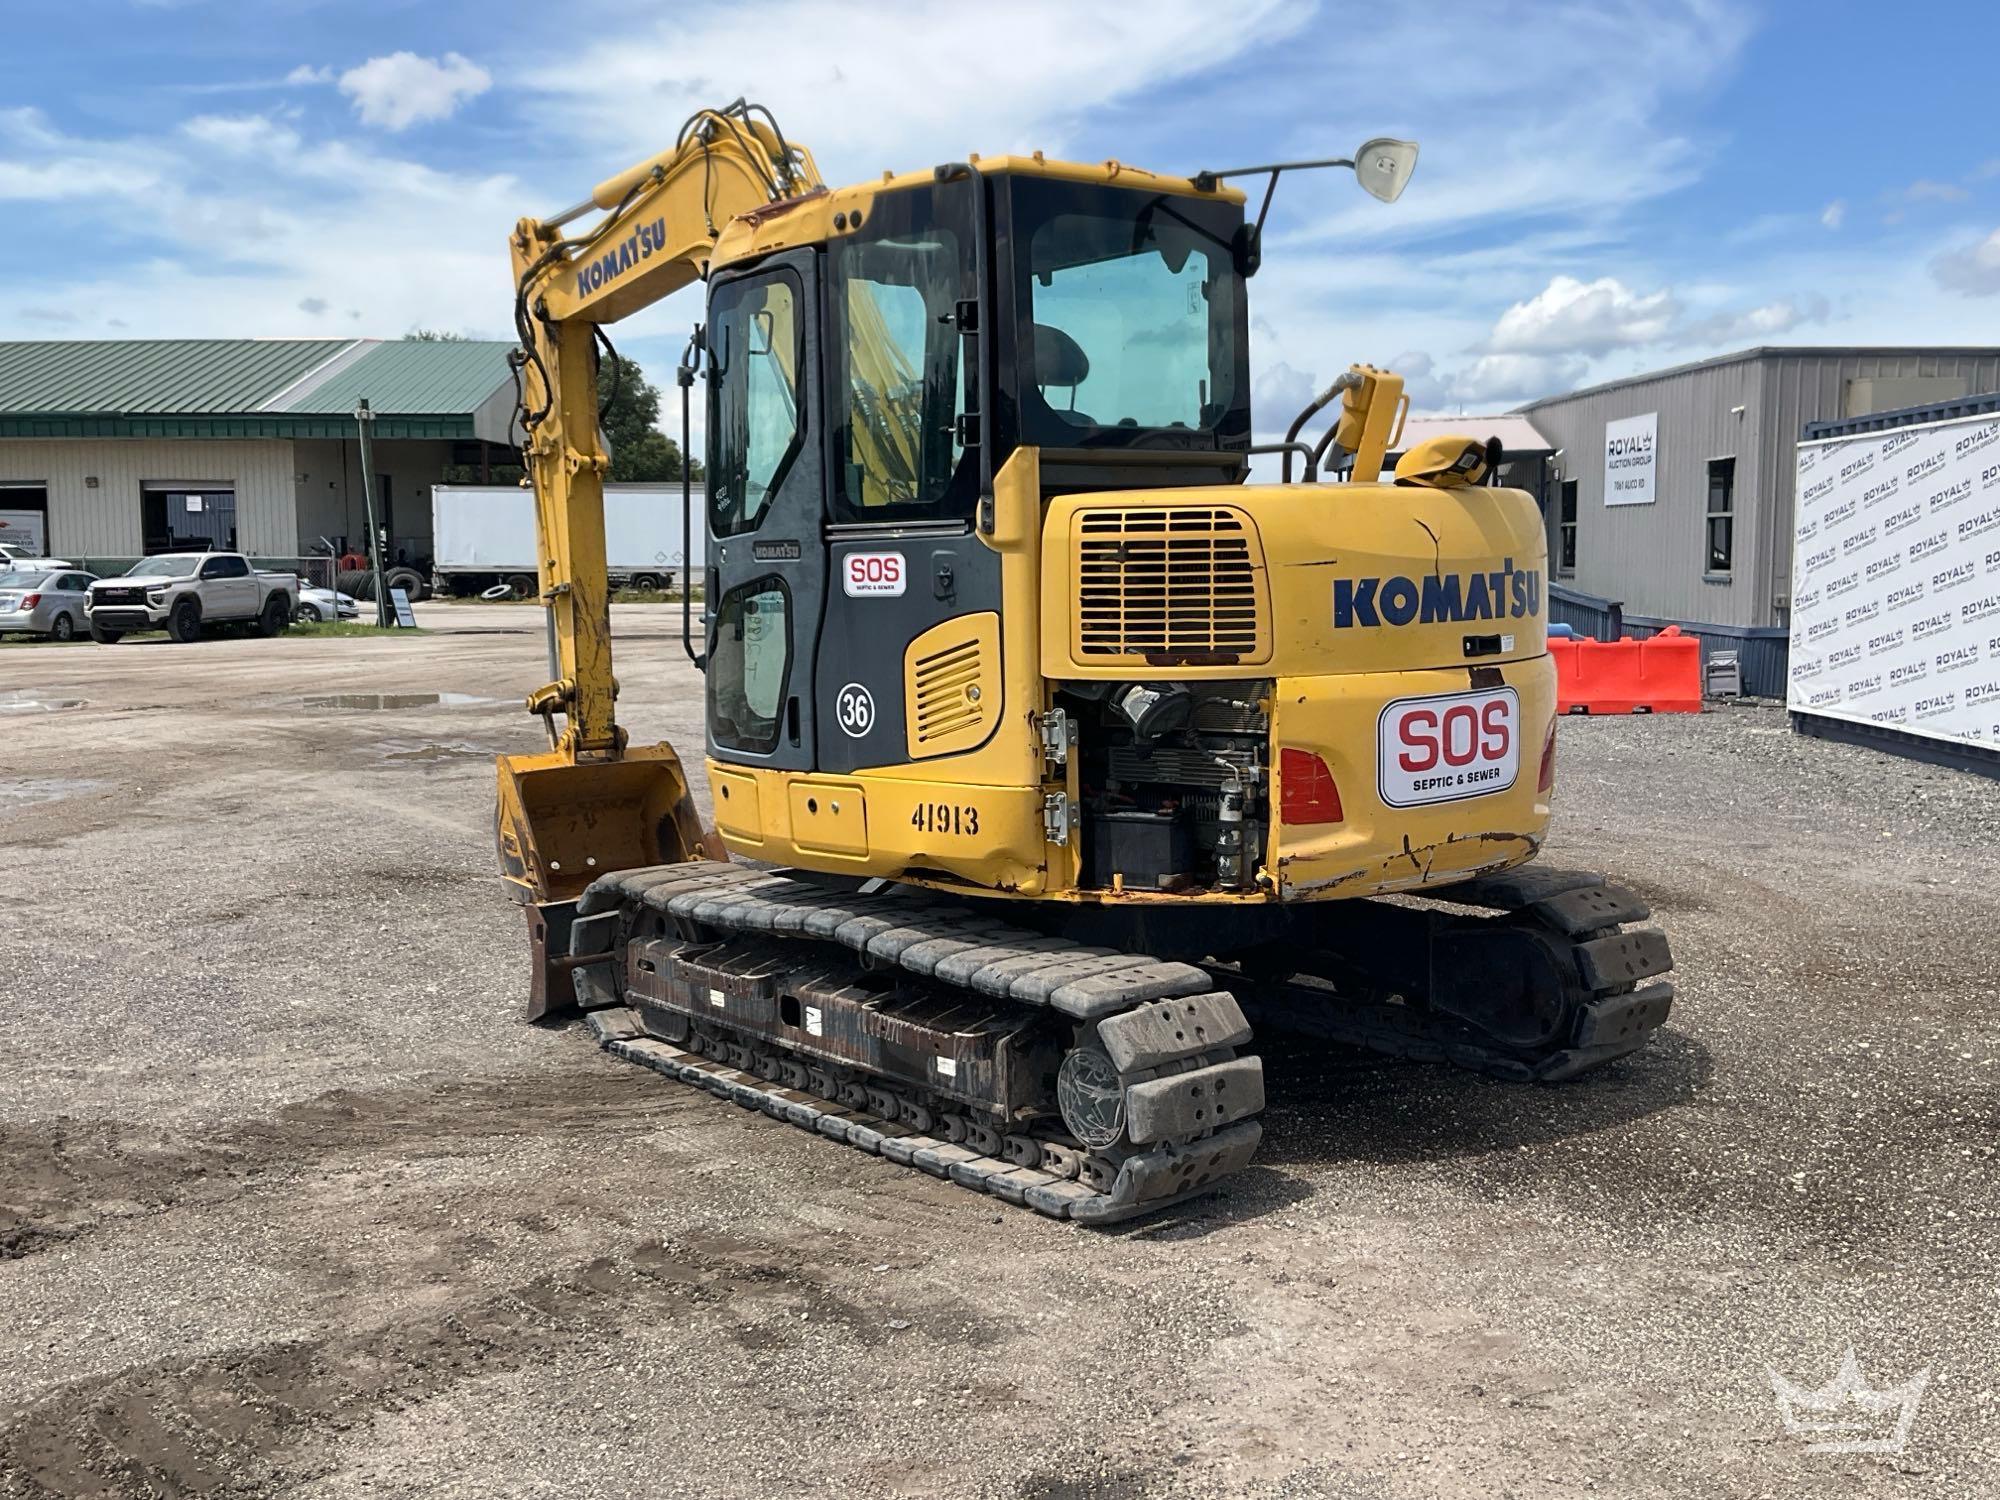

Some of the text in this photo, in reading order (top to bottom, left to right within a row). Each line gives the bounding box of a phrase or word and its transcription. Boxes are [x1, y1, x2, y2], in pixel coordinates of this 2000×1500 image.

[578, 217, 666, 300] KOMATSU
[1608, 436, 1642, 456] ROYAL
[1956, 429, 1989, 452] ROYAL
[1608, 456, 1652, 469] AUCTION GROUP
[1841, 457, 1866, 477] ROYAL
[1907, 457, 1937, 478] ROYAL
[1864, 481, 1890, 501] ROYAL
[1930, 485, 1962, 506] ROYAL
[1884, 509, 1913, 528] ROYAL
[1958, 513, 1992, 534] ROYAL
[756, 543, 799, 558] KOMATSU
[1909, 536, 1939, 555] ROYAL
[851, 558, 899, 582] SOS
[1866, 558, 1892, 575] ROYAL
[1933, 566, 1965, 585] ROYAL
[1334, 558, 1540, 628] KOMATSU
[1888, 586, 1916, 603] ROYAL
[1962, 597, 1996, 616] ROYAL
[1912, 616, 1942, 633] ROYAL
[1868, 634, 1895, 649] ROYAL
[1936, 649, 1968, 665] ROYAL
[1890, 665, 1918, 680] ROYAL
[1965, 683, 2000, 698] ROYAL
[842, 692, 868, 727] 36
[1915, 697, 1946, 711] ROYAL
[1398, 700, 1510, 772] SOS
[1413, 768, 1500, 791] SEPTIC & SEWER
[912, 803, 979, 835] 41913
